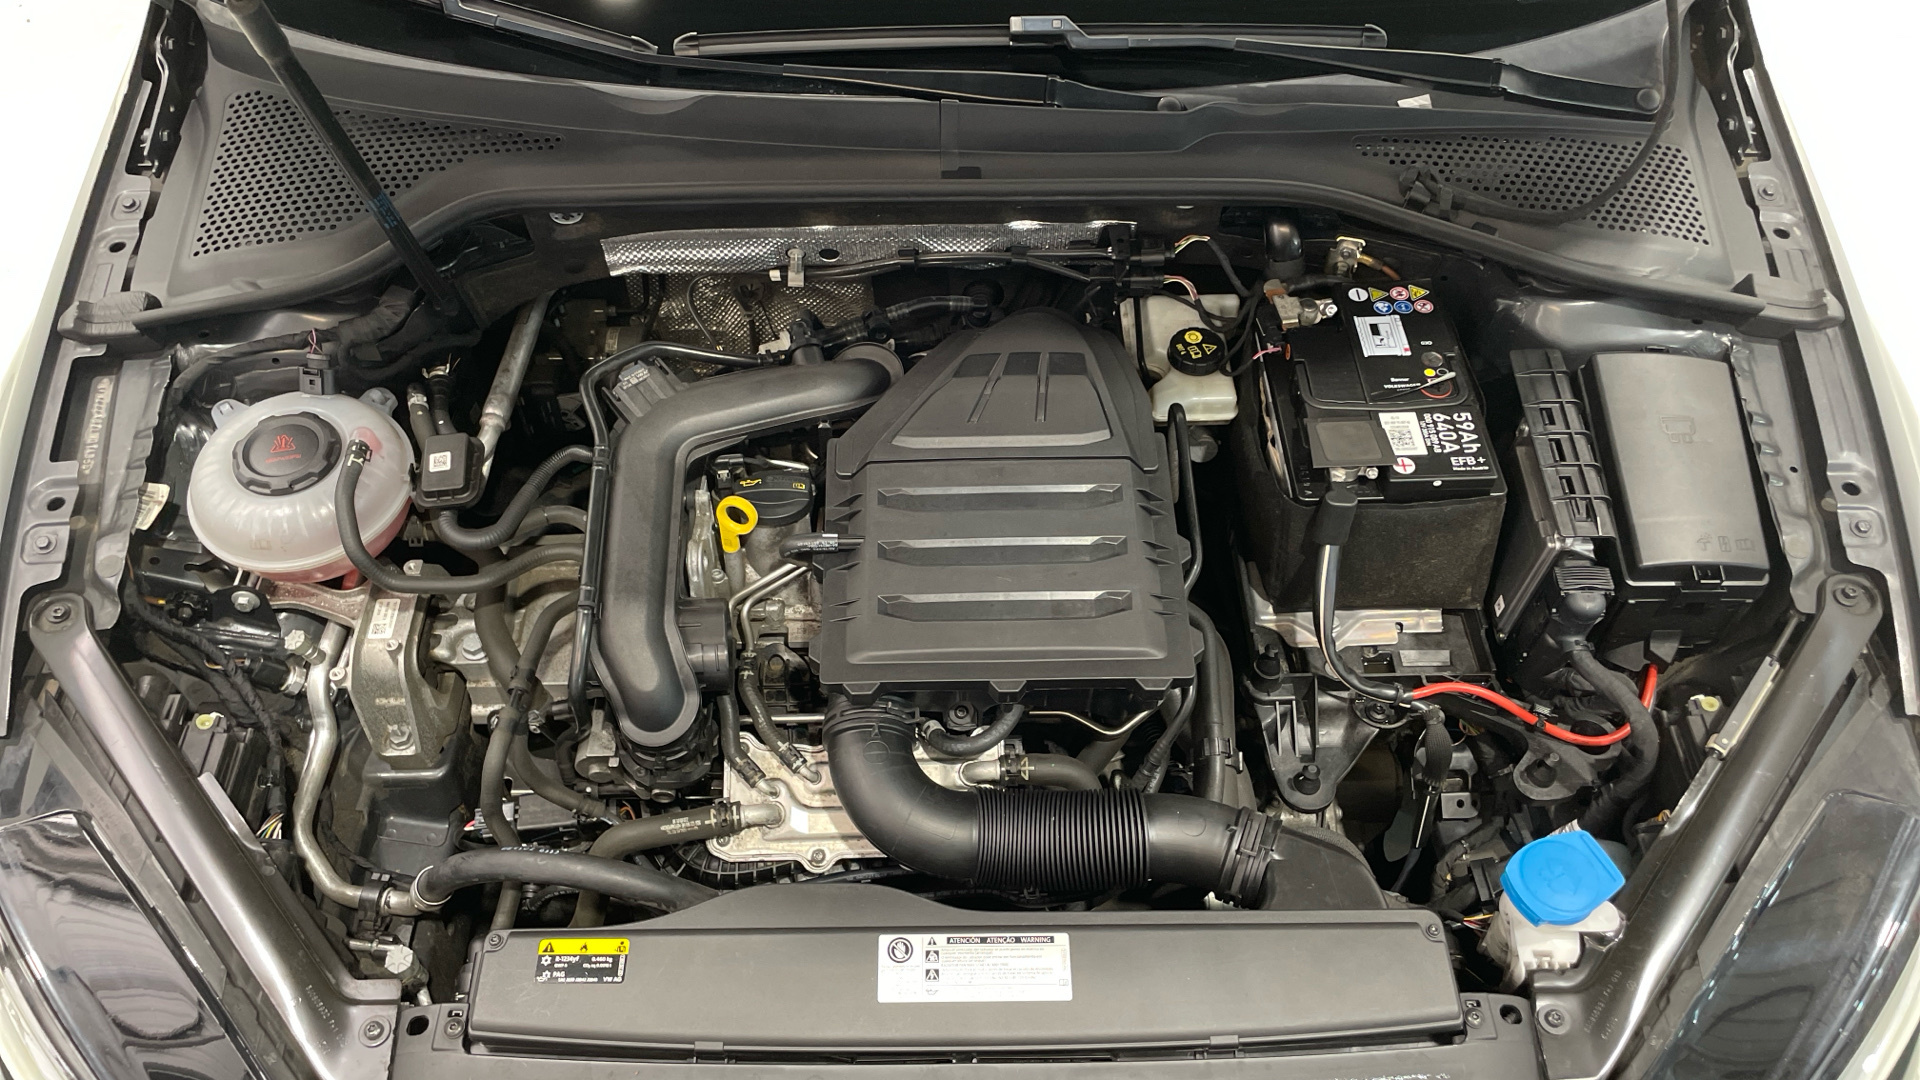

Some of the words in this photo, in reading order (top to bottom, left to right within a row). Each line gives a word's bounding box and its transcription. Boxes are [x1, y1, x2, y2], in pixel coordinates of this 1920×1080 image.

[1432, 413, 1460, 453] 640A
[1453, 412, 1481, 453] 59Ah
[949, 936, 981, 944] ATENCIÓN
[986, 936, 1016, 945] ATENÇÃO
